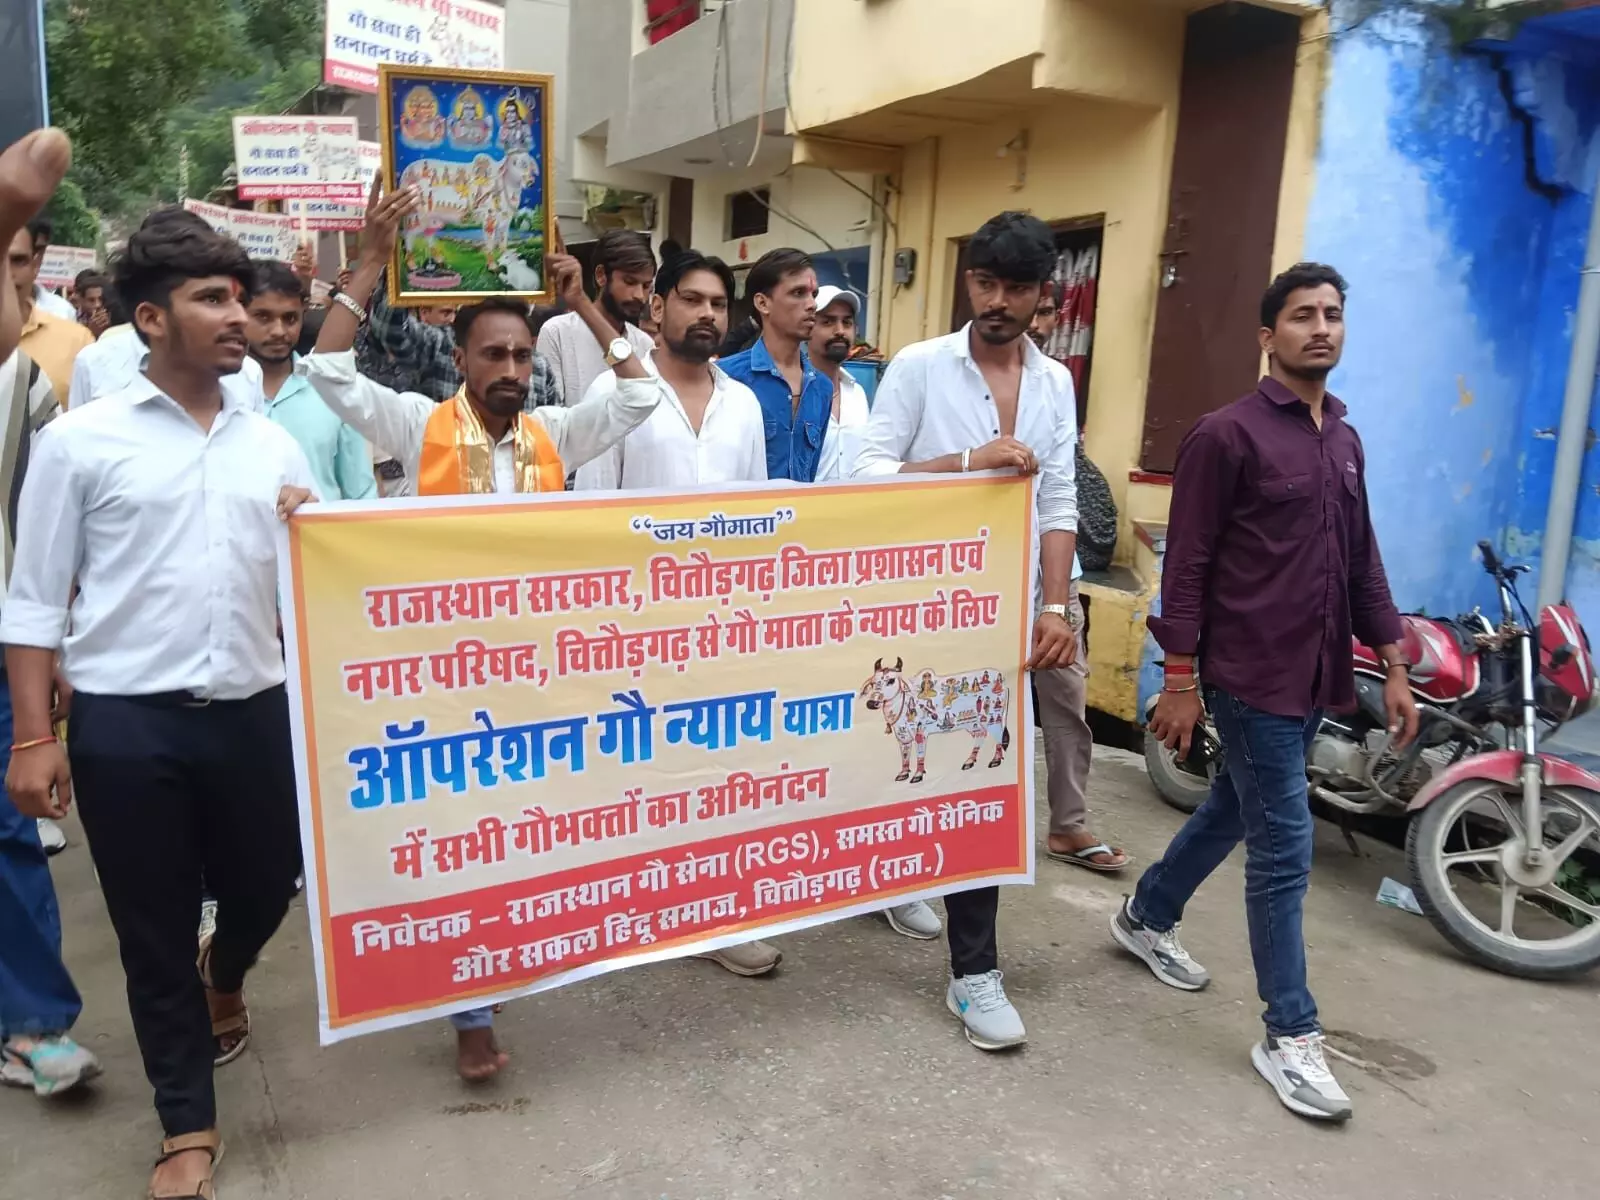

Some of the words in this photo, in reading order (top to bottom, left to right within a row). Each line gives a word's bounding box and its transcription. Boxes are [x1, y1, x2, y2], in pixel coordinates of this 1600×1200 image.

[366, 578, 520, 627] राजस्थान
[527, 569, 642, 612] सरकार,
[781, 546, 852, 590] जिला
[855, 541, 944, 586] प्रशासन
[949, 529, 987, 573] एवं
[344, 656, 423, 700] नगर
[430, 640, 548, 687] परिषद,
[556, 623, 690, 677] चित्तौड़गढ़
[696, 615, 720, 658] से
[726, 609, 758, 654] गौ
[764, 613, 824, 650] माता
[829, 600, 853, 642] के
[859, 607, 917, 637] न्याय
[923, 590, 947, 631] के
[952, 589, 1000, 629] लिए
[348, 711, 588, 809] ऑपरेशन
[597, 690, 656, 764] गौ
[664, 691, 776, 750] न्याय
[783, 692, 855, 736] यात्रा
[352, 911, 472, 956] निवेदक
[506, 873, 632, 926] राजस्थान
[638, 859, 668, 893] गौ
[675, 852, 729, 885] सेना
[735, 830, 829, 878] (RGS),
[837, 817, 904, 851] समस्त
[907, 807, 933, 835] गौ
[938, 798, 1004, 832] सैनिक
[391, 828, 427, 879] में
[432, 817, 507, 873] सभी
[512, 788, 643, 855] गौभक्तों
[645, 791, 690, 830] का
[697, 762, 828, 819] अभिनंदन
[452, 945, 513, 983] और
[519, 926, 599, 970] सकल
[604, 908, 657, 947] हिंदू
[657, 892, 747, 931] समाज,
[754, 866, 861, 909] चित्तौड़गढ़
